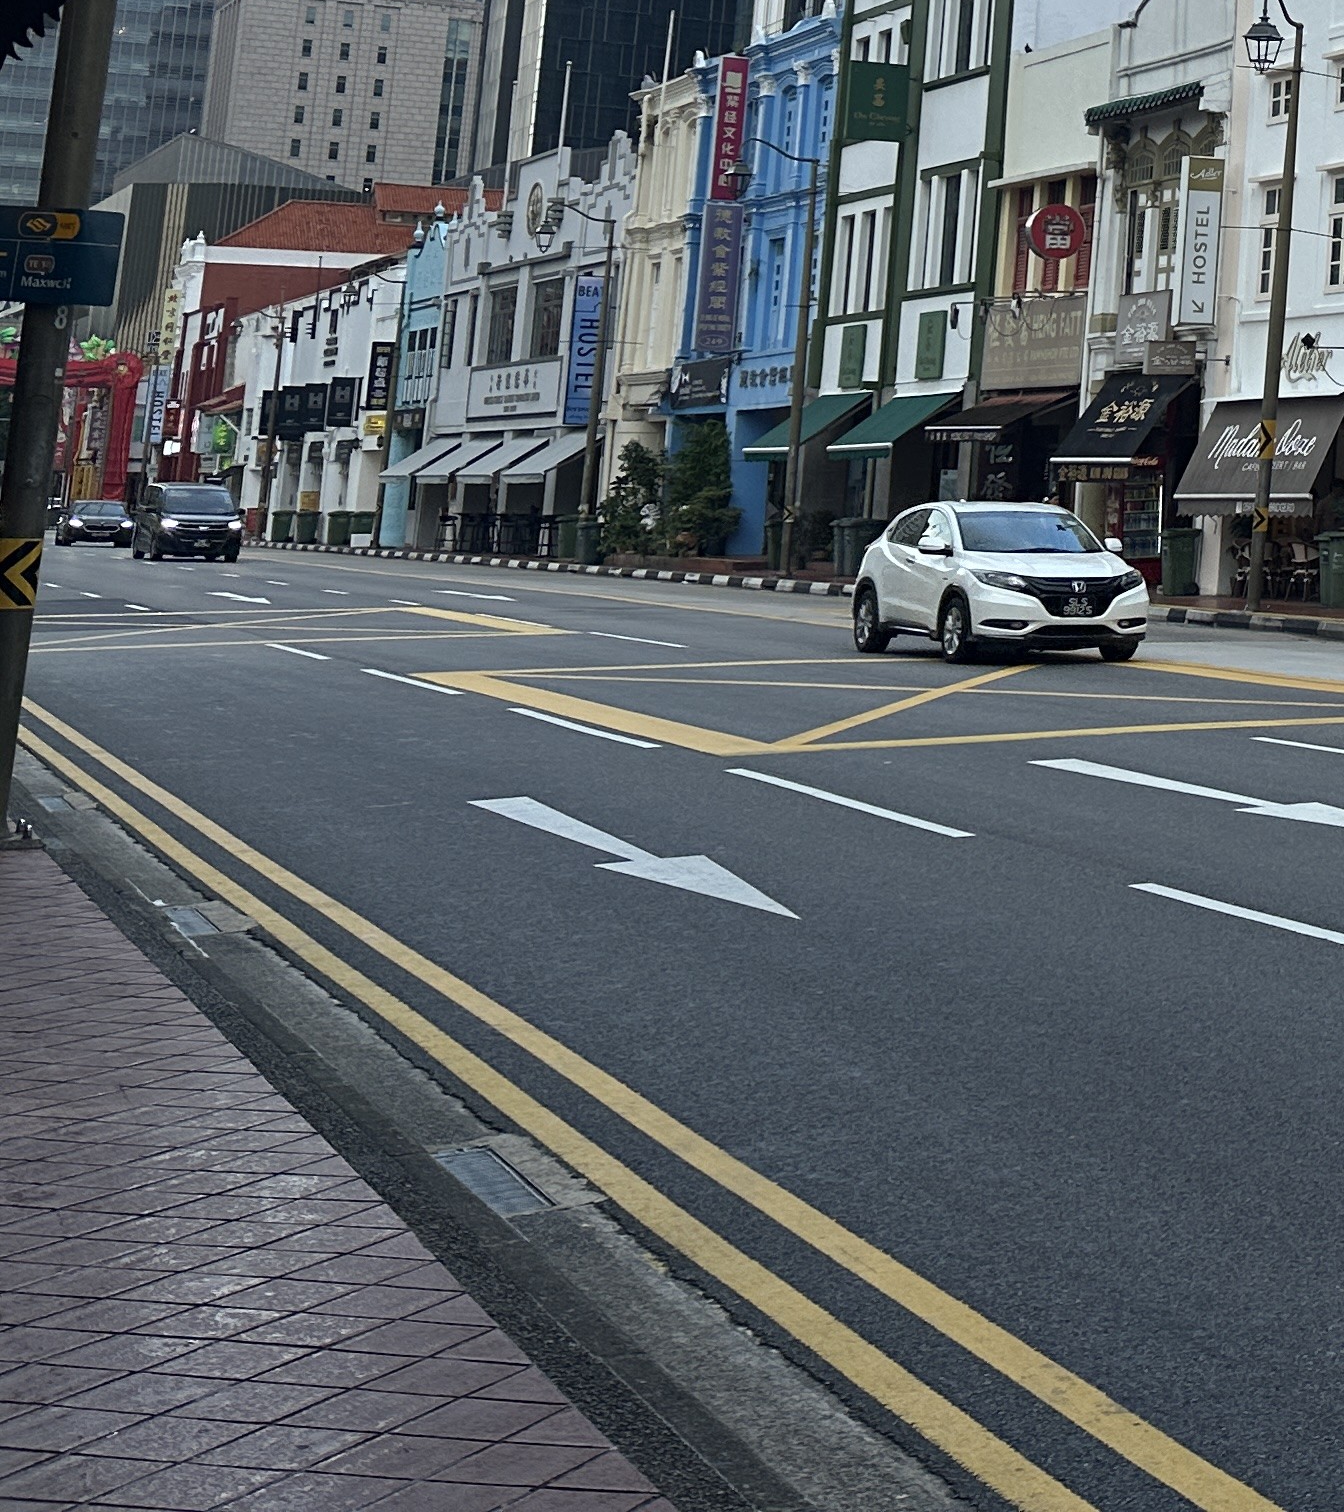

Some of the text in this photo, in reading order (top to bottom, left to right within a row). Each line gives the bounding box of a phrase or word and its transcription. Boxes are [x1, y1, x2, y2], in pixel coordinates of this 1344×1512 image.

[1043, 214, 1074, 250] 當
[1192, 206, 1210, 284] HOSTEL
[578, 285, 603, 297] BEA
[1059, 310, 1082, 338] FATT
